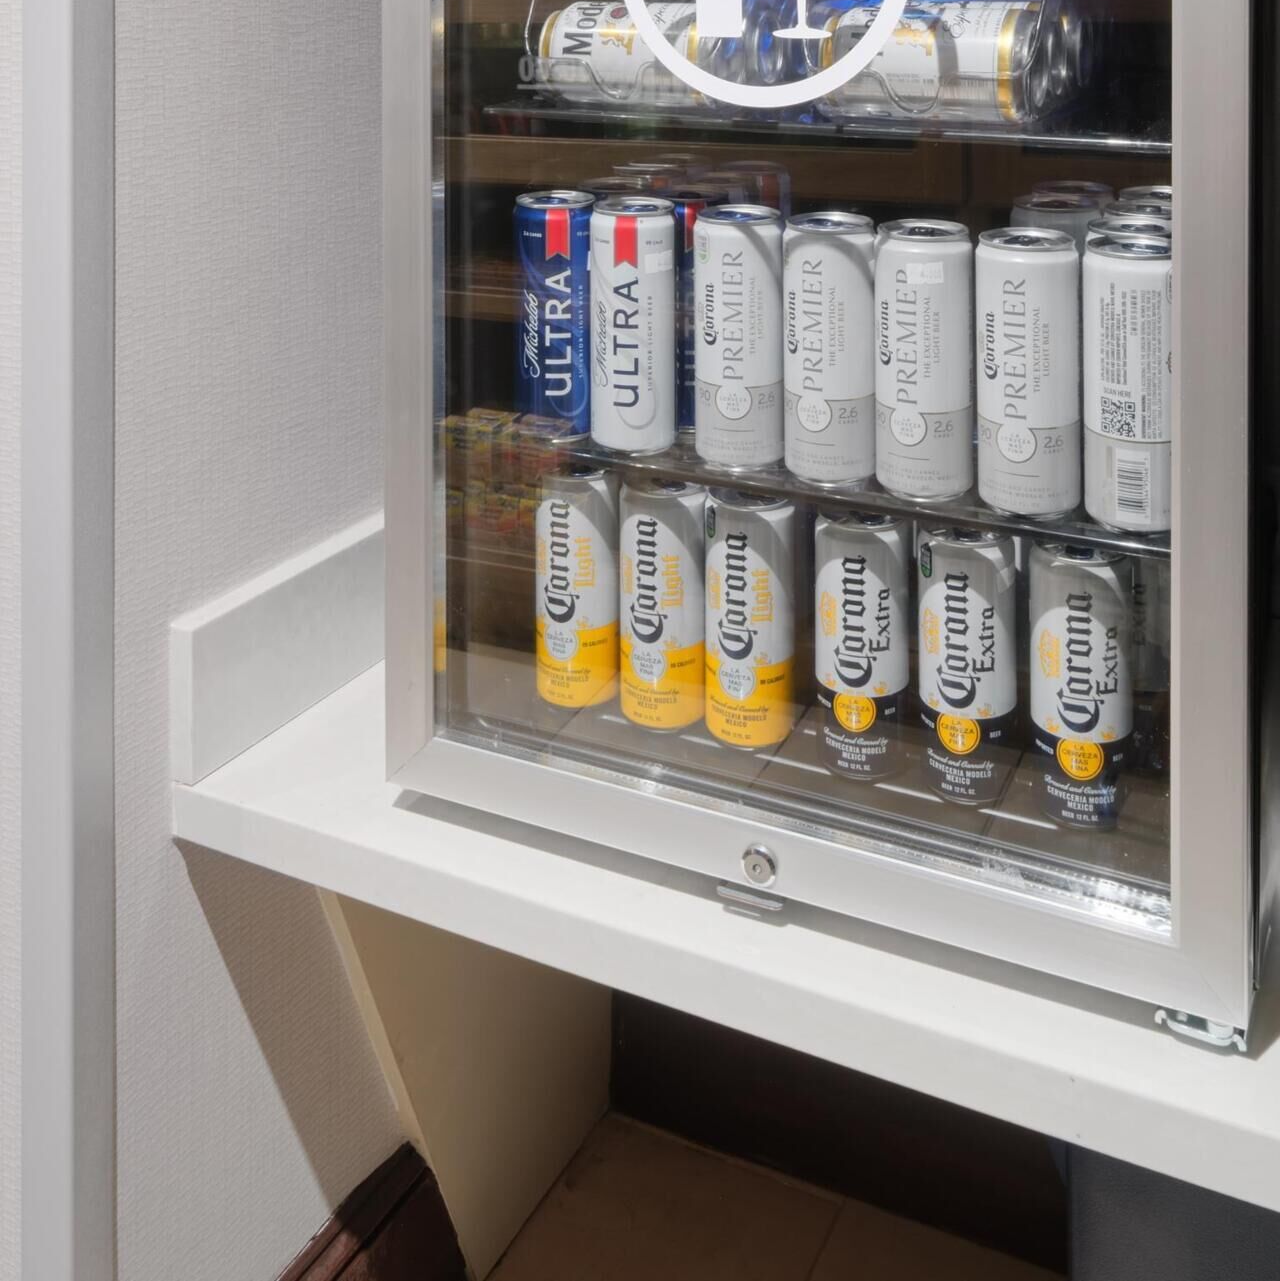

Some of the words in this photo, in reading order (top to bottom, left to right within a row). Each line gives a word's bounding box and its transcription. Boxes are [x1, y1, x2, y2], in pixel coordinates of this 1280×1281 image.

[523, 289, 541, 379] Michelob
[545, 270, 572, 397] ULTRA
[594, 301, 610, 388] Michelob
[613, 276, 640, 408] ULTRA
[704, 282, 719, 346] Corona
[722, 251, 743, 379] PREMIER
[787, 289, 800, 354] Corona
[802, 259, 823, 392] PREMIER
[879, 299, 893, 366] Corona
[984, 311, 1000, 380] Corona
[1003, 279, 1027, 420] PREMIER
[1042, 348, 1050, 377] LIGHT
[839, 406, 858, 419] 2.6
[933, 420, 954, 433] 2.6
[1043, 435, 1064, 449] 2.6
[544, 499, 580, 623] Corona
[573, 536, 596, 588] Light
[630, 517, 668, 644] Corona
[661, 554, 685, 609] Light
[718, 531, 758, 660] Corona
[750, 567, 773, 623] Light
[834, 555, 877, 688] Corona
[869, 588, 891, 657] Extra
[937, 571, 982, 709] Corona
[972, 606, 995, 675] Extra
[1056, 592, 1104, 733] Corona
[1096, 625, 1119, 696] Extra
[842, 752, 866, 761] MEXICO
[945, 773, 971, 786] MEXICO
[1067, 800, 1094, 812] MEXICO
